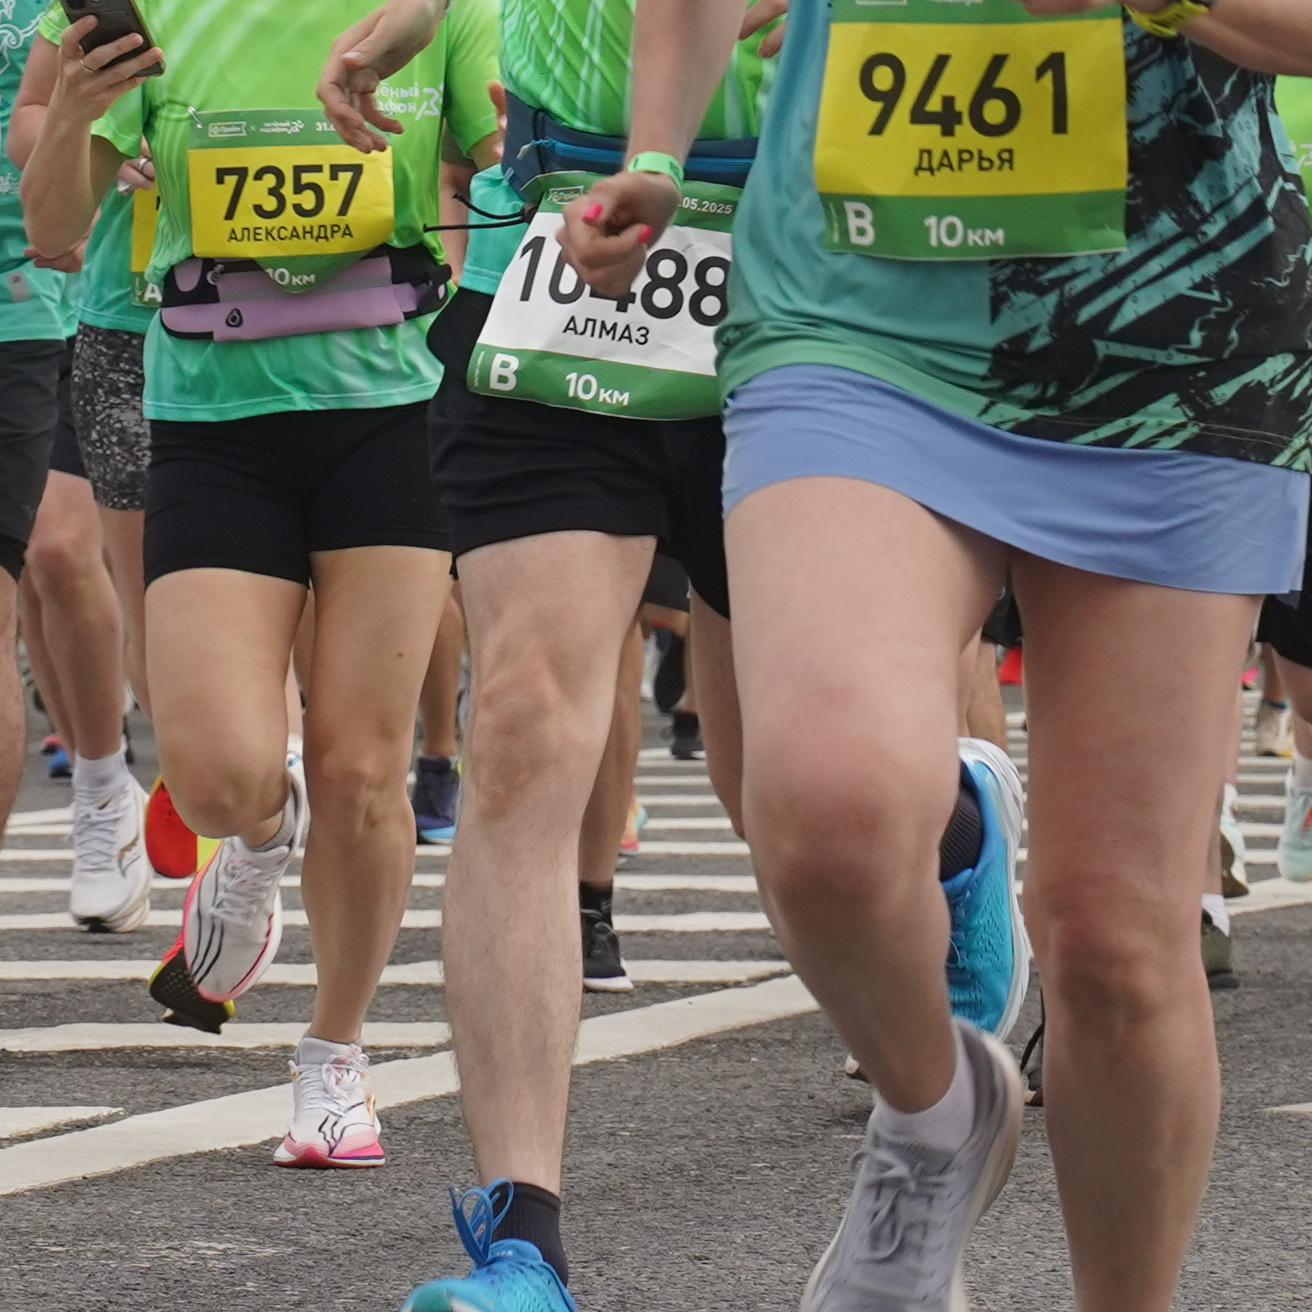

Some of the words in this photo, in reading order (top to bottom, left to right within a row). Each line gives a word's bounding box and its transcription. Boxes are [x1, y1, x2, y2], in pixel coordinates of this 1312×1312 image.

[858, 50, 1069, 138] 9461
[913, 148, 1015, 177] ДАРЬЯ
[215, 163, 364, 221] 7357
[227, 223, 354, 243] АЛЕКСАНДРА
[562, 315, 651, 346] АЛМАЗ
